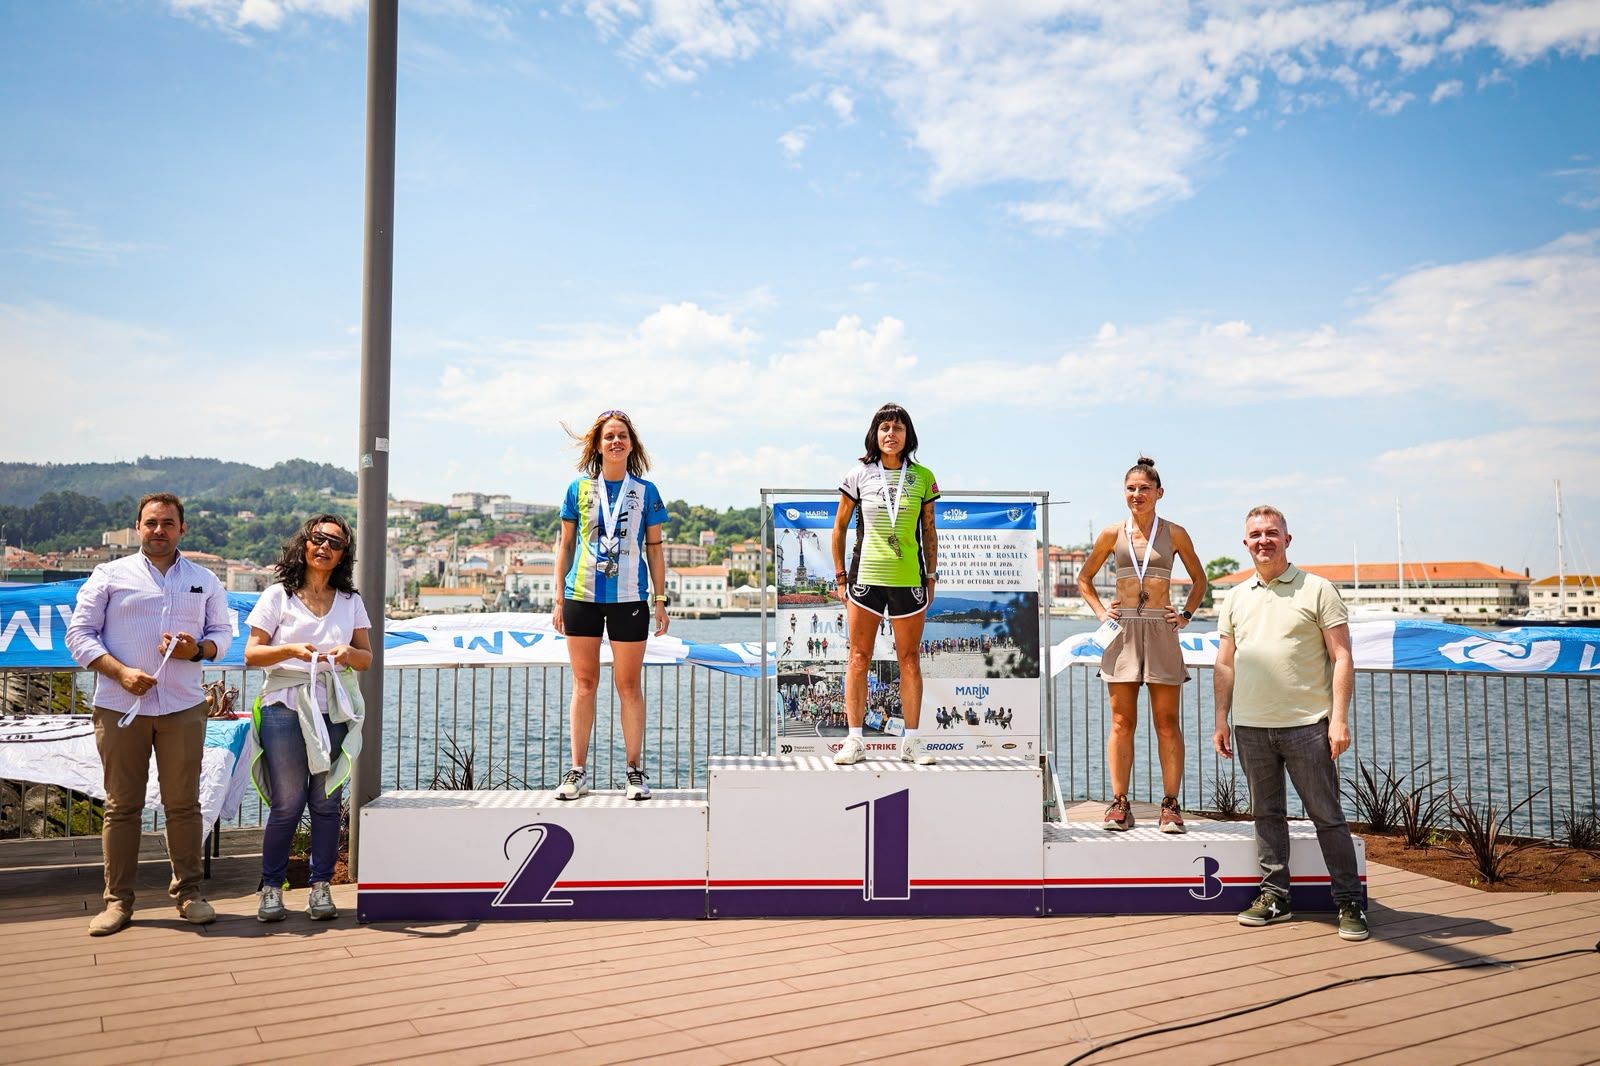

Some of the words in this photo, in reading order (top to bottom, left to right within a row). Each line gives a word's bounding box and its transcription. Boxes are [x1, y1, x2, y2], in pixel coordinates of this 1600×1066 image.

[926, 743, 964, 751] BROOKS
[491, 823, 575, 906] 2
[845, 788, 910, 901] 1
[1188, 856, 1224, 901] 3
